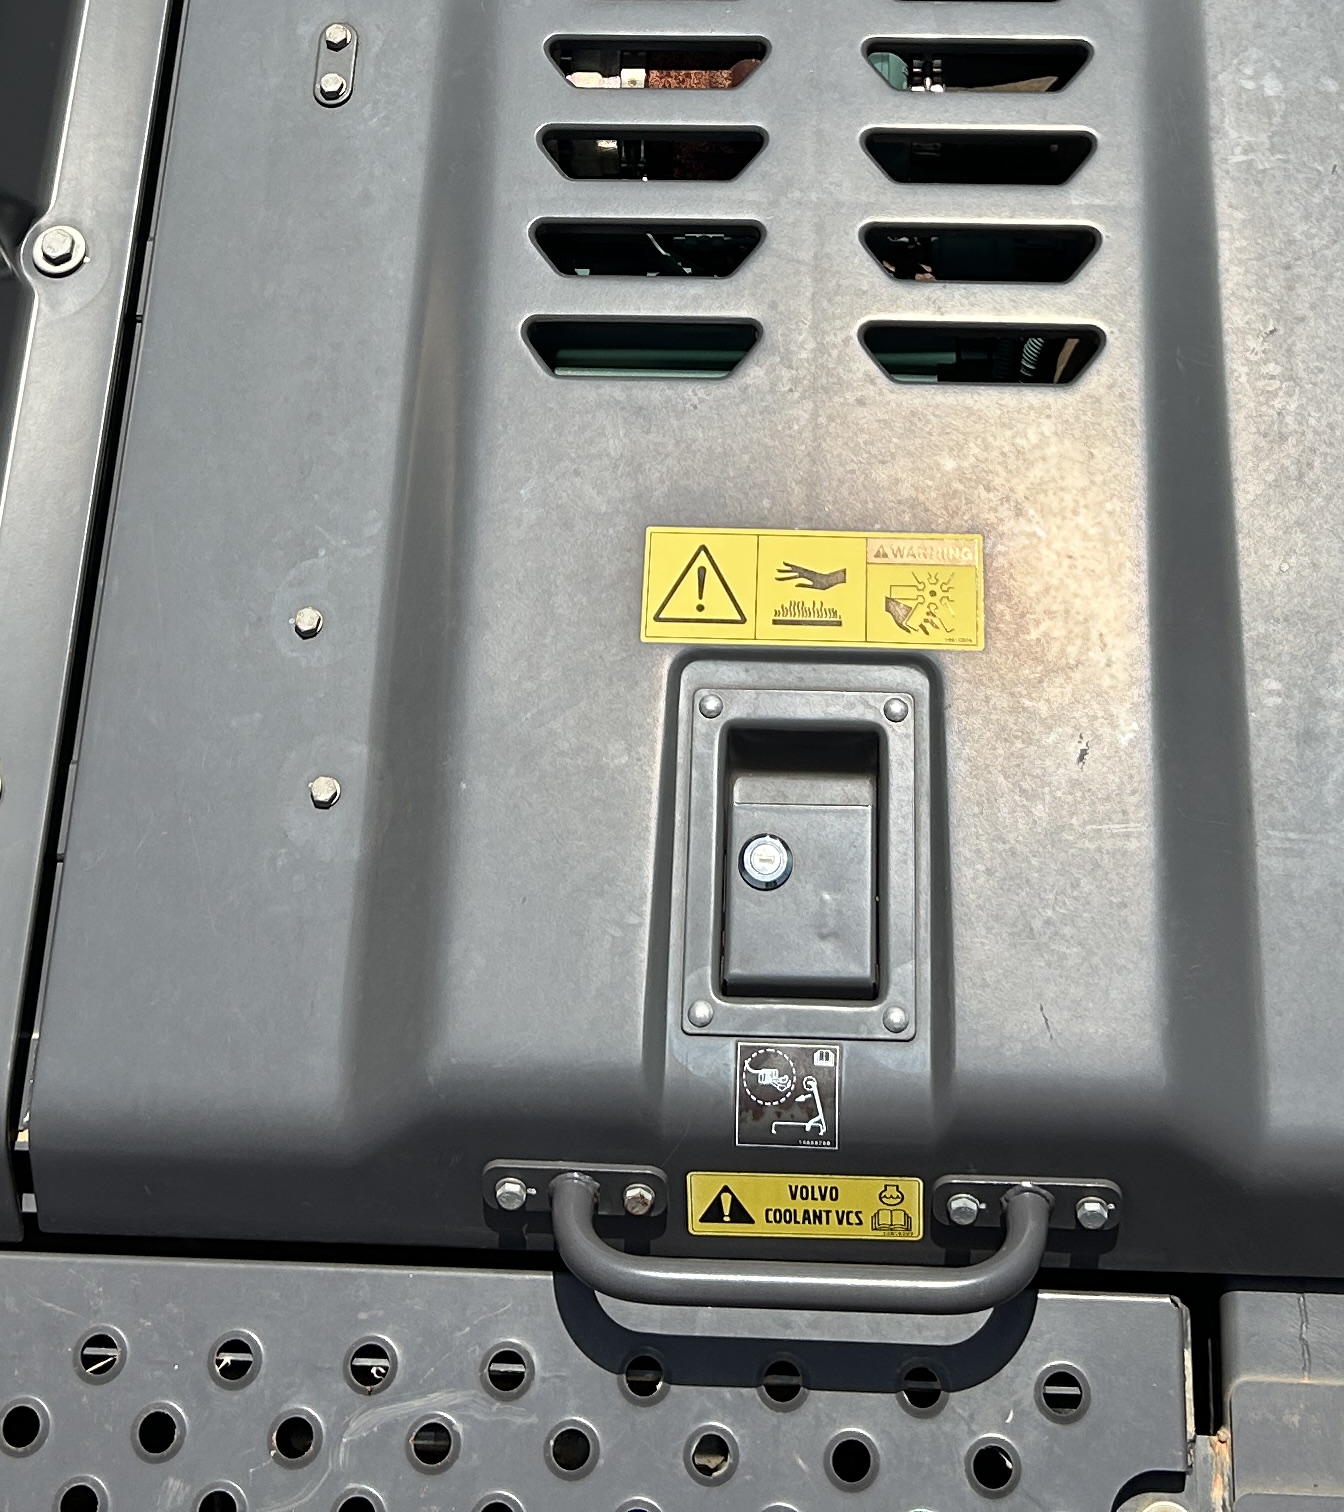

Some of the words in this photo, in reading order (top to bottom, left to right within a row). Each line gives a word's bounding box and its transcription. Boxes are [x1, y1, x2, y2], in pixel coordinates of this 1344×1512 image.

[890, 544, 973, 561] WARNING
[788, 1184, 839, 1202] VOLVO
[764, 1208, 832, 1225] COOLANT
[835, 1209, 864, 1226] VCS
